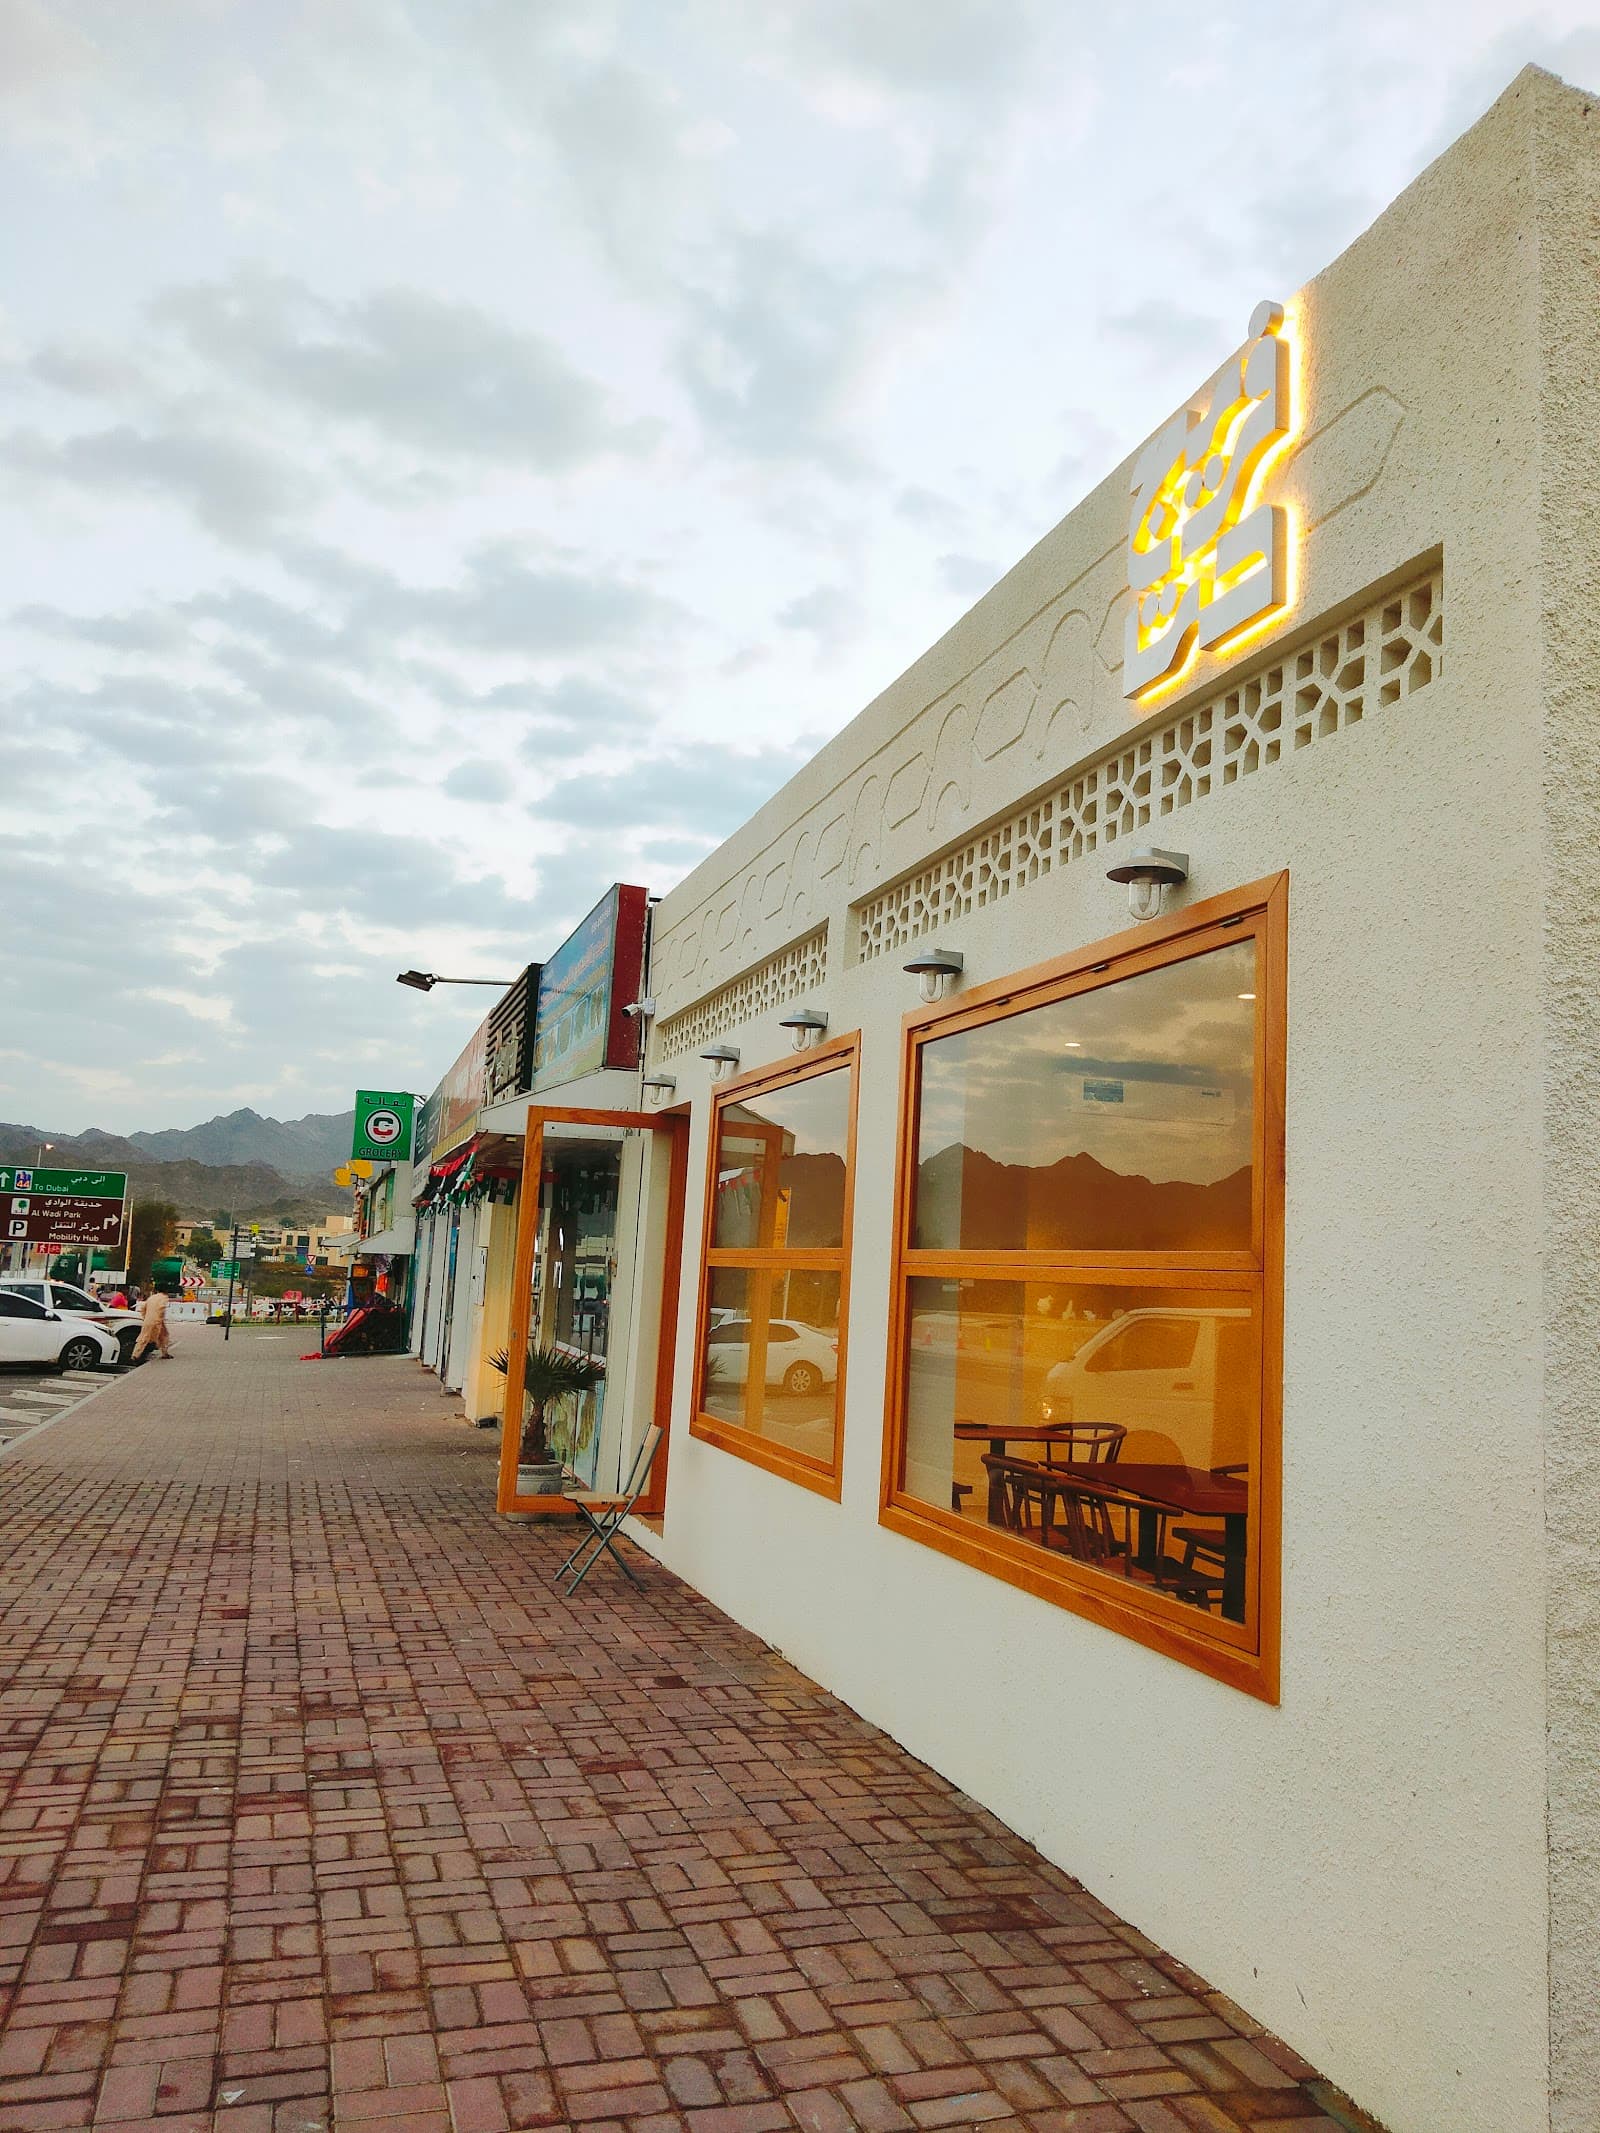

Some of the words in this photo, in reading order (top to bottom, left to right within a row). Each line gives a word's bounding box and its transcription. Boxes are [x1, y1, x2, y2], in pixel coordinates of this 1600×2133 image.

[364, 1096, 407, 1109] بقالة
[358, 1148, 402, 1158] GROCERY
[16, 1180, 30, 1188] 44
[70, 1176, 88, 1185] دبي
[46, 1184, 69, 1192] Dubai
[44, 1198, 71, 1207] الوادي
[73, 1199, 102, 1209] حديقة
[31, 1209, 40, 1217] Al
[42, 1210, 62, 1218] Wadi
[63, 1211, 82, 1219] Park
[13, 1221, 25, 1235] P
[48, 1233, 81, 1242] Mobility
[82, 1234, 99, 1242] Hub
